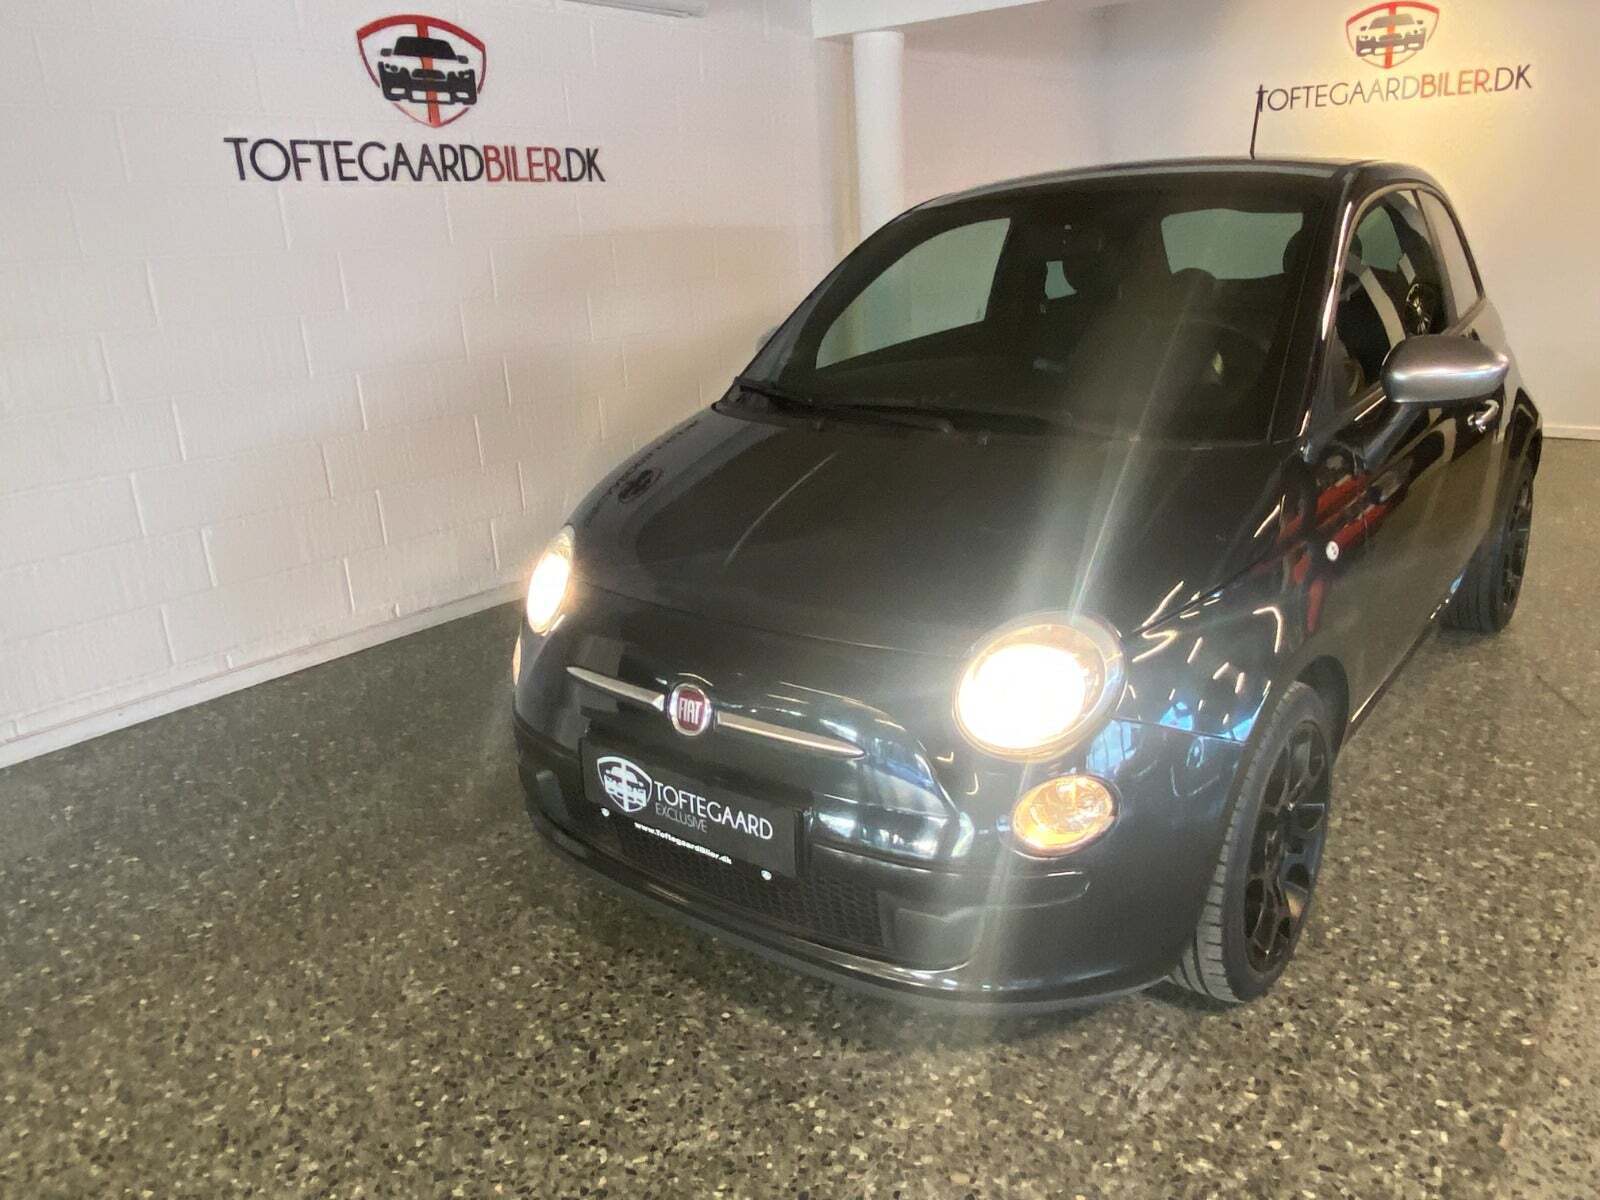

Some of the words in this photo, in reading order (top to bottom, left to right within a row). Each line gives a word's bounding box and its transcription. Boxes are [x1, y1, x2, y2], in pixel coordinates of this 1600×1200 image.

[223, 137, 606, 183] TOFTEGAARDBILER.DK
[678, 697, 703, 724] FIAT
[654, 781, 774, 840] TOFTEGAARD
[655, 802, 708, 834] EXCLUSIVE
